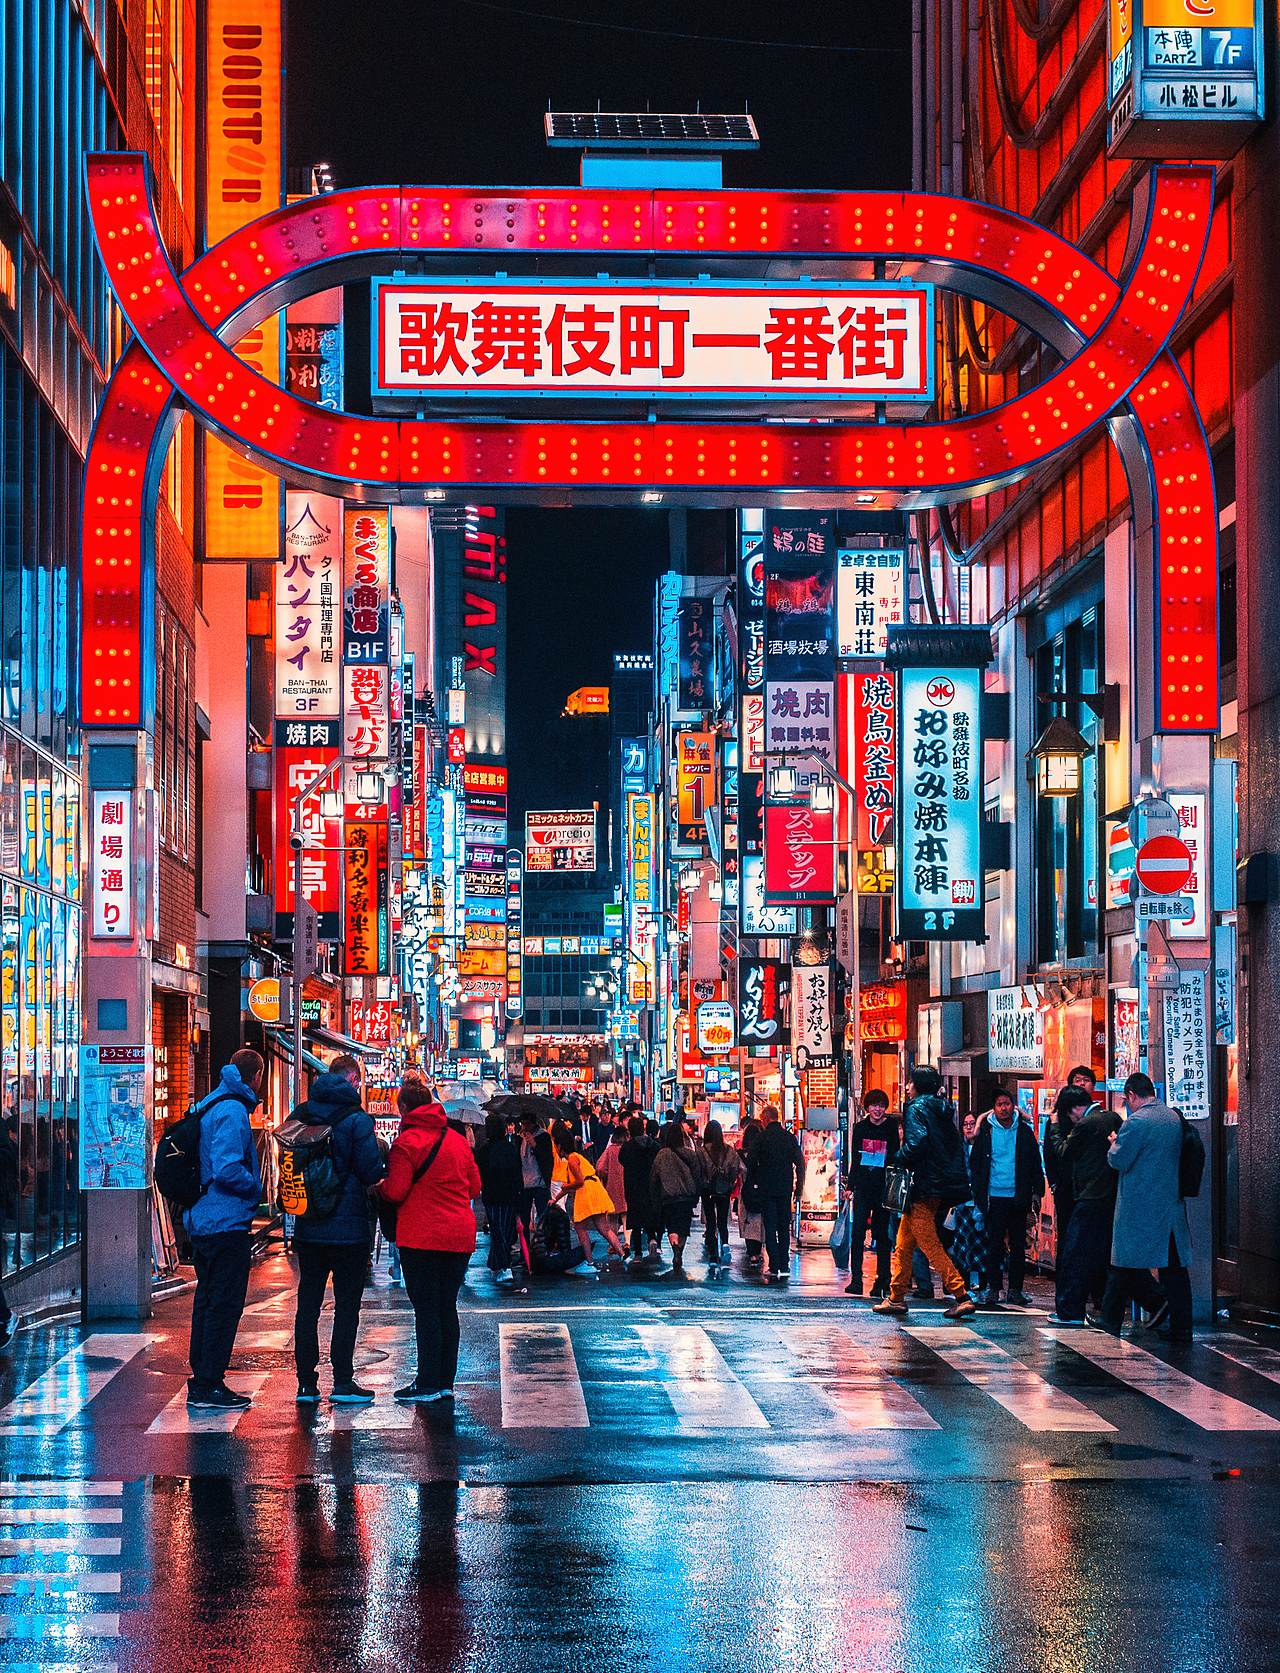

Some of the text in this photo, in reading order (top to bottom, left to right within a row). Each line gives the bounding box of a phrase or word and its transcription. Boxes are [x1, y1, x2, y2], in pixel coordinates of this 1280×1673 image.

[1154, 30, 1193, 50] 本陣
[1209, 30, 1242, 64] 7F
[1155, 51, 1197, 64] PART2
[1160, 84, 1238, 108] 小松ビル
[398, 301, 908, 381] 歌舞伎町一番街
[286, 536, 330, 547] RESTAURANT
[745, 540, 757, 549] 4F
[840, 554, 900, 568] 全卓全自動
[354, 517, 381, 634] まぐろ商店
[283, 554, 316, 673] バンタイ
[320, 555, 333, 664] タイ国料理専門店
[854, 571, 876, 656] 東南荘
[347, 642, 384, 658] B1F
[840, 644, 851, 656] 3F
[282, 687, 333, 695] RESTAURANT
[288, 679, 328, 687] BAN-THAI
[295, 698, 319, 711] 3F
[286, 723, 330, 745] 焼肉
[747, 698, 764, 769] クアトロ
[683, 747, 711, 761] 麻雀
[861, 675, 893, 845] 焼鳥釜めし
[684, 764, 710, 772] ナンバー
[683, 776, 704, 821] 1
[913, 708, 949, 895] お好み焼本陣
[354, 806, 378, 818] 4F
[685, 827, 708, 840] 4F
[785, 808, 817, 889] ステップ
[100, 800, 124, 924] 劇場通り
[862, 873, 894, 893] 2F
[1139, 902, 1189, 916] 自転車を除く
[777, 923, 795, 932] B1F
[924, 911, 955, 931] 2F
[463, 958, 490, 970] ゲーム
[806, 972, 830, 1047] お好み焼き
[1165, 995, 1173, 1025] Security
[706, 1028, 731, 1040] 190円
[1173, 1016, 1181, 1040] Safety
[1180, 983, 1195, 1095] 防犯カメラ作動中
[1192, 976, 1205, 1101] みなさまの安全を守ります
[1166, 1027, 1174, 1058] Camera
[458, 1068, 479, 1077] ゲーム
[813, 1058, 832, 1067] B1F
[1168, 1067, 1176, 1102] Operation
[283, 1150, 297, 1198] NORTH
[292, 1171, 307, 1198] THE
